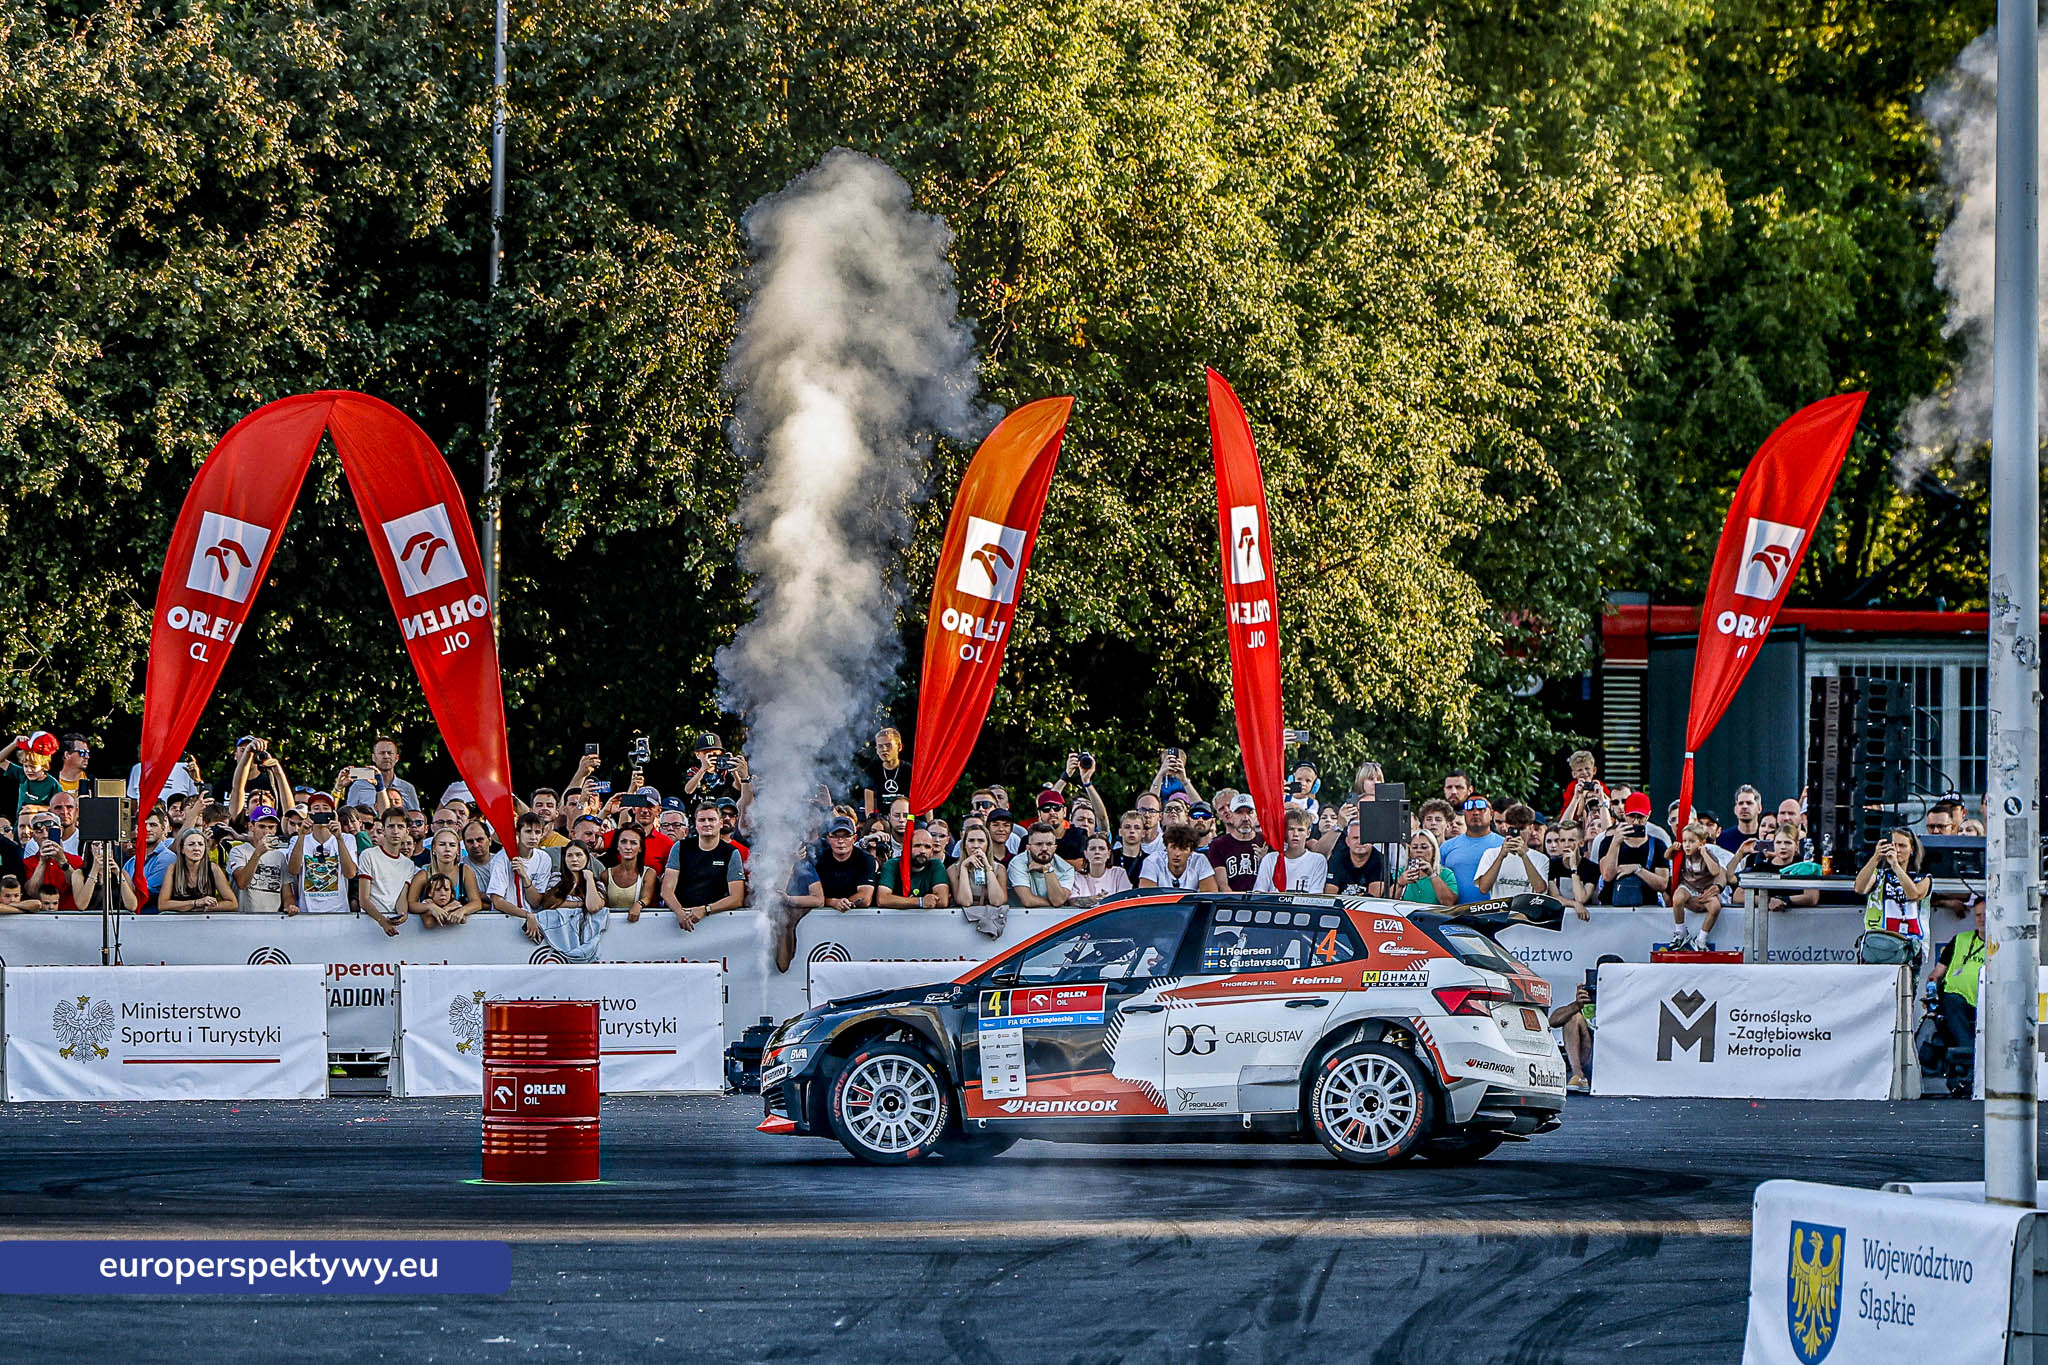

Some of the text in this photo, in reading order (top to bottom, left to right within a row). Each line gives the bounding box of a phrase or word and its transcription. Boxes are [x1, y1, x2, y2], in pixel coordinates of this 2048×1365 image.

[167, 606, 243, 645] ORE
[1469, 901, 1509, 913] SKODA
[1316, 929, 1338, 963] 4
[1511, 946, 1573, 962] ództwo
[1219, 958, 1291, 968] S.Gustavsson
[1292, 975, 1343, 985] Helmia
[1056, 990, 1088, 999] ORLEN
[121, 1002, 241, 1020] Ministerstwo
[988, 991, 1002, 1017] 4
[1020, 1017, 1032, 1025] ERC
[1033, 1015, 1074, 1024] Championship
[1729, 1008, 1812, 1026] Górnośląsko
[121, 1026, 282, 1046] Sportu i Turystyki
[1225, 1030, 1304, 1044] CARLGUSTAV
[1727, 1043, 1802, 1060] Metropolia
[523, 1084, 566, 1095] ORLEN
[523, 1096, 541, 1105] OIL
[1862, 1237, 1974, 1285] Województwo
[1858, 1281, 1917, 1330] Śląskie
